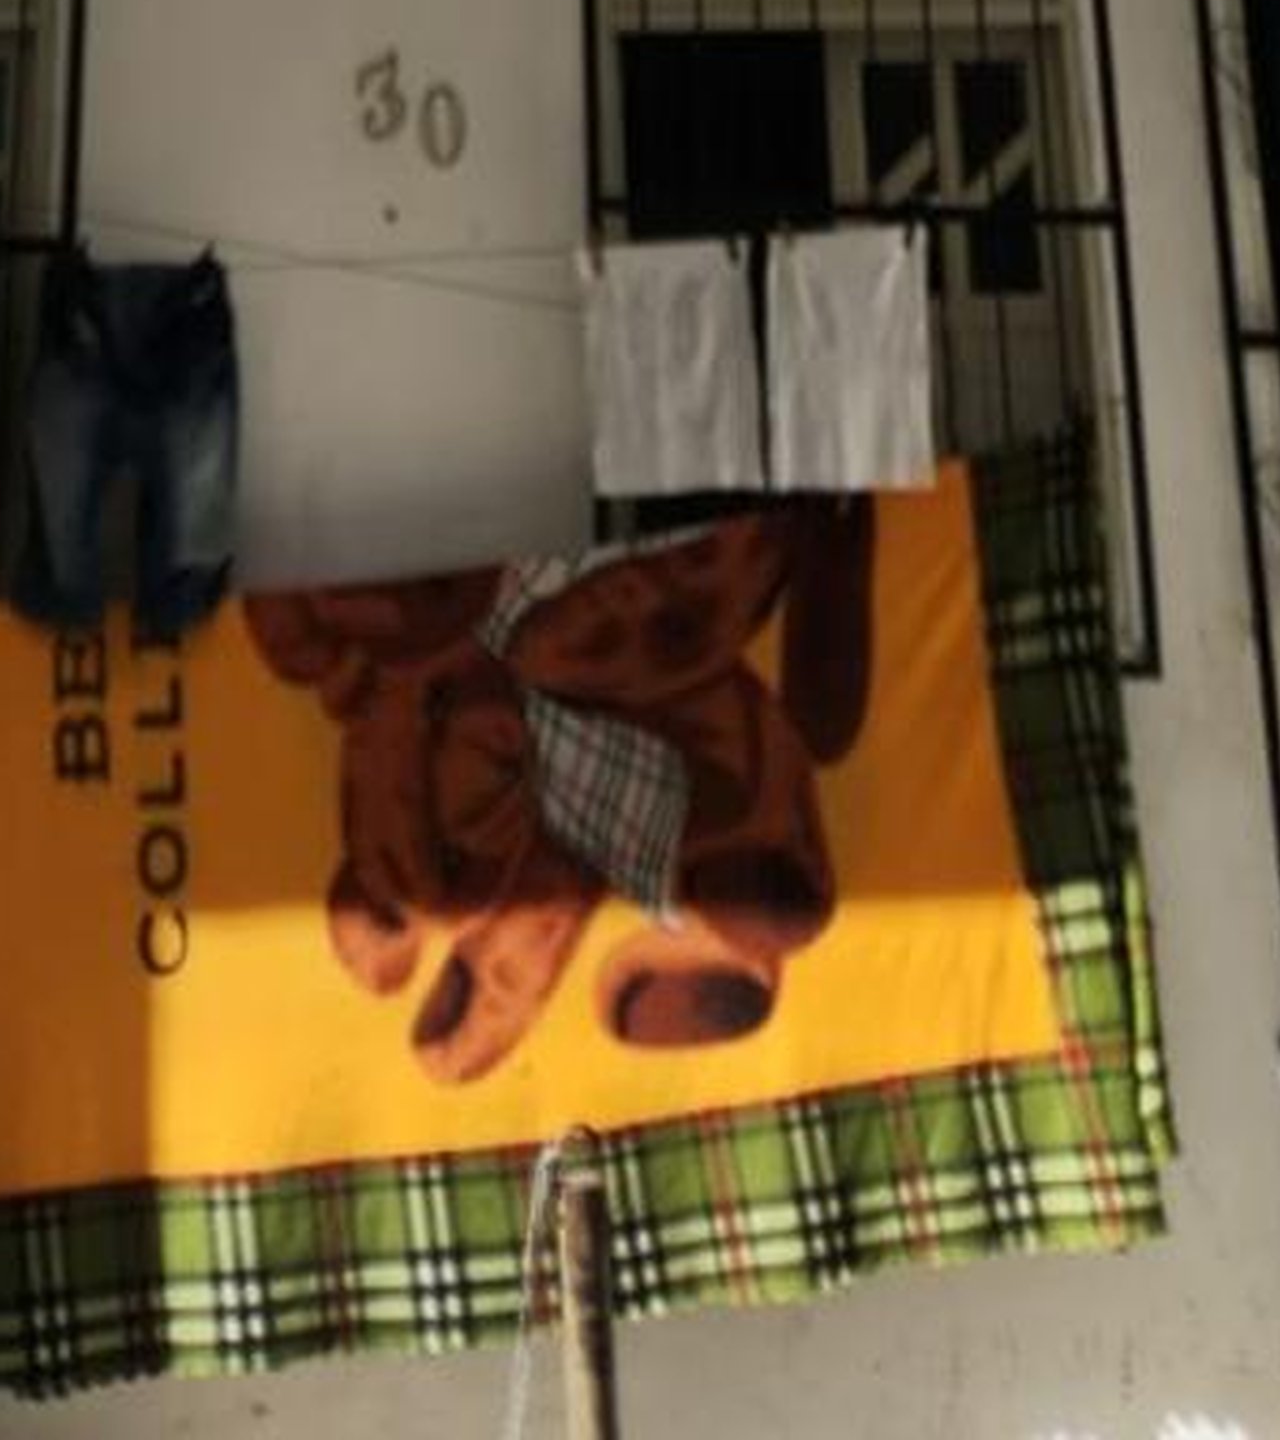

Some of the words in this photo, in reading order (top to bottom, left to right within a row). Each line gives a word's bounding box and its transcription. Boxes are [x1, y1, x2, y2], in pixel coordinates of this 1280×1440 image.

[354, 46, 468, 170] 30
[54, 630, 109, 782] BE
[130, 638, 189, 976] COLL
